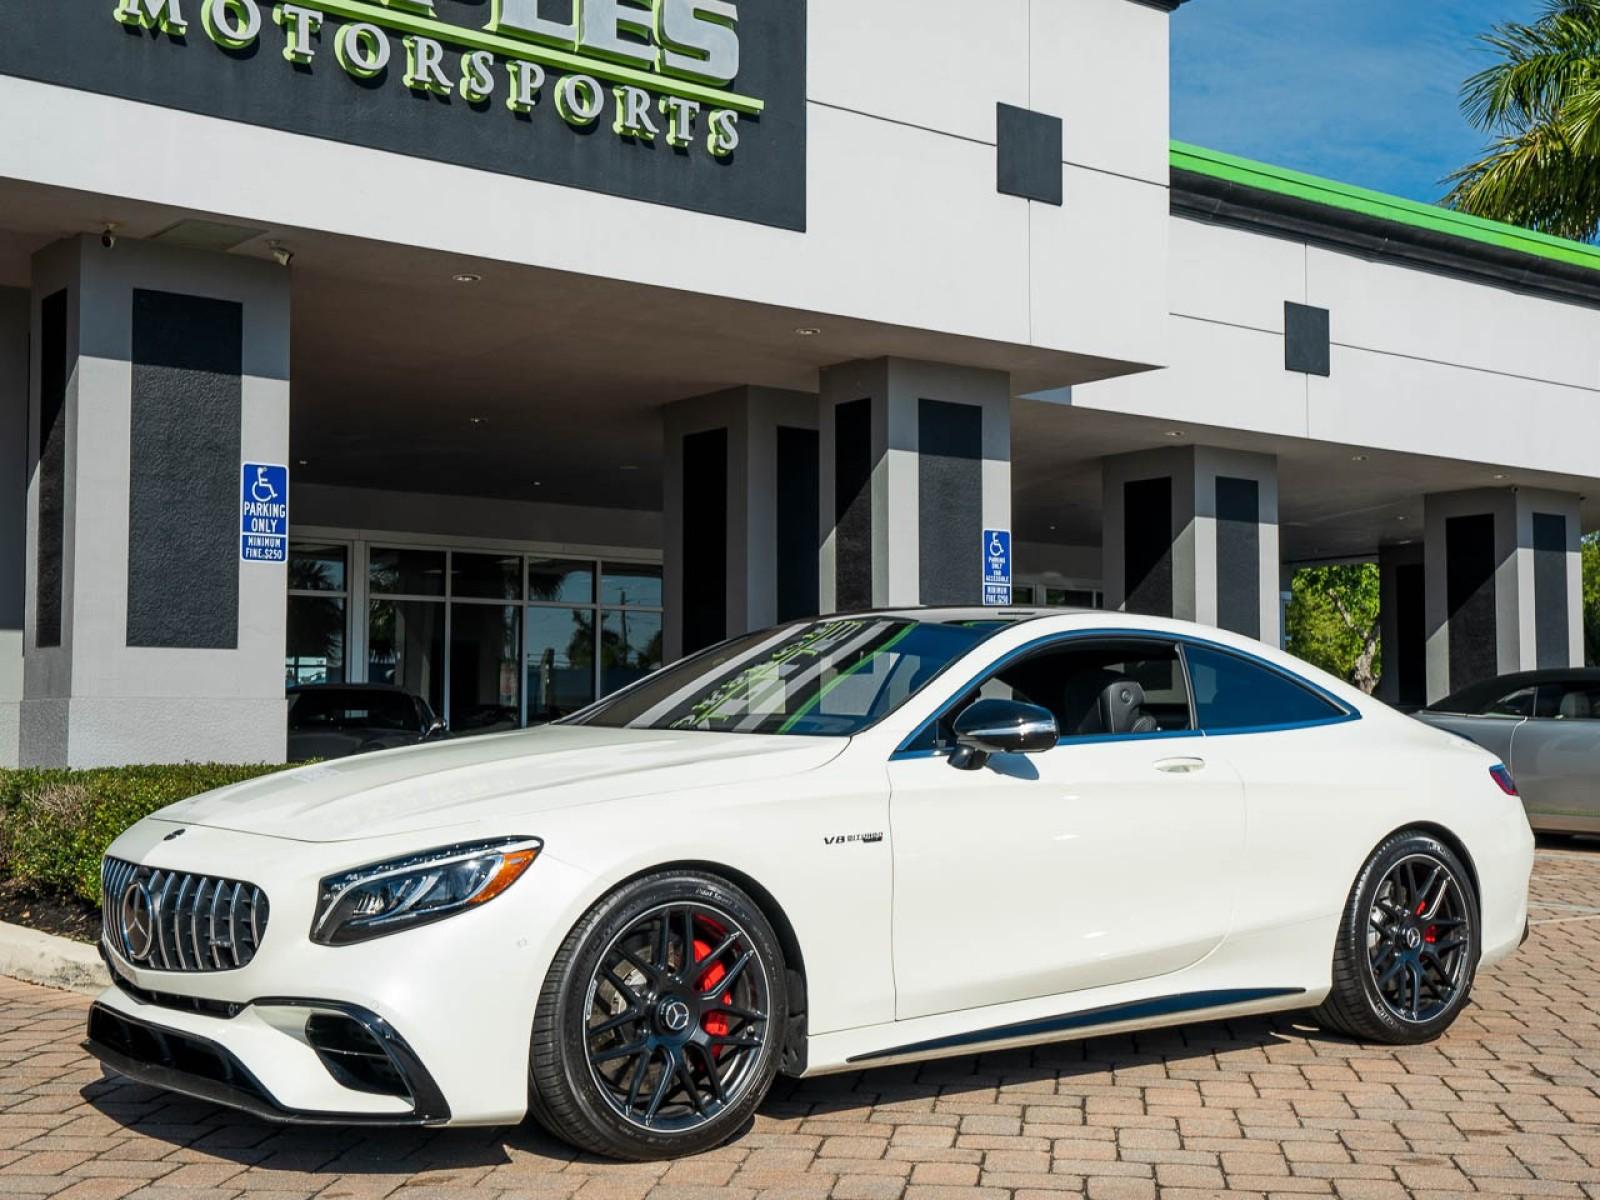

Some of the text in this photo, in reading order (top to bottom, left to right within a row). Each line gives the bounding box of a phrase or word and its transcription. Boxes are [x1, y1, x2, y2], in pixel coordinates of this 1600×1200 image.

[244, 501, 286, 518] PARKING
[251, 518, 277, 532] ONLY
[248, 536, 281, 548] MINIMUM
[824, 835, 845, 845] V8
